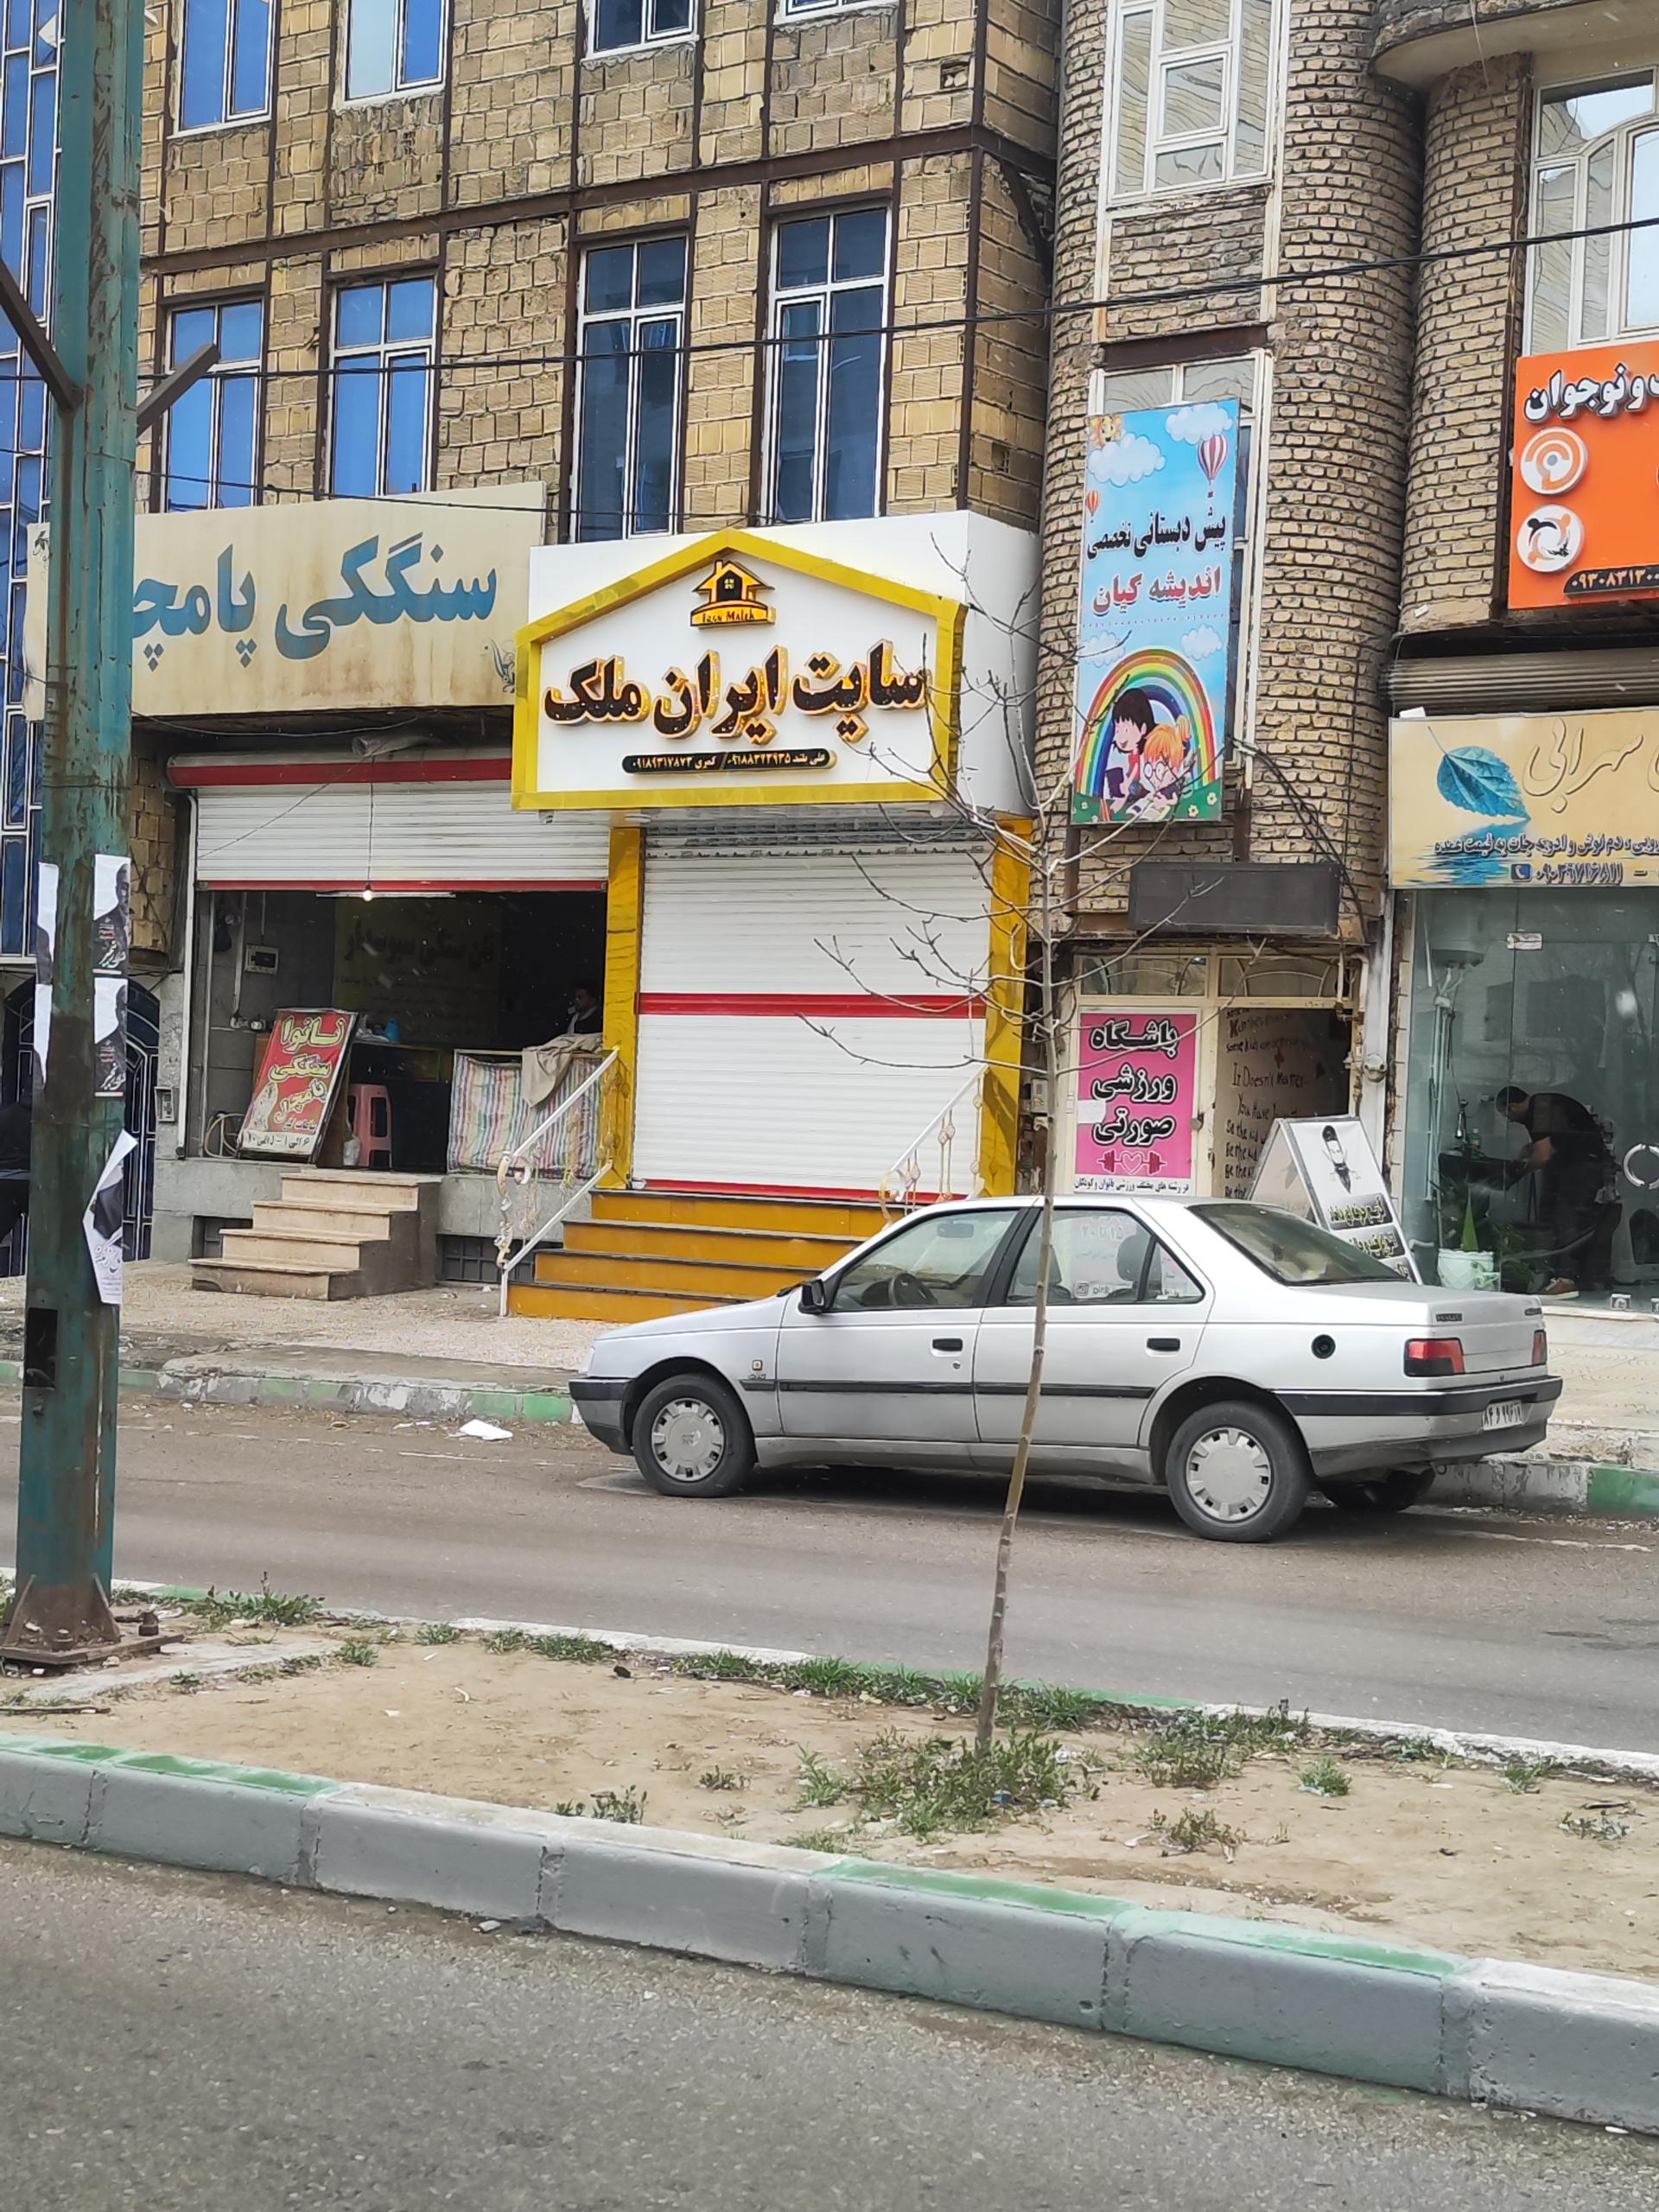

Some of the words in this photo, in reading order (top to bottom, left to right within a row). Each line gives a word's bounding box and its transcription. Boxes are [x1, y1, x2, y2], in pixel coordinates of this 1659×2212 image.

[1523, 363, 1629, 423] نوجوان
[1135, 512, 1191, 557] دبستانی
[1195, 506, 1225, 552] پیش
[131, 543, 257, 671] پامچ
[275, 531, 497, 660] سنگکی
[1093, 573, 1142, 616] کیان
[1149, 566, 1221, 609] اندیشه
[543, 654, 652, 725] ملک
[652, 645, 788, 745] ایران
[792, 639, 931, 743] سایت
[1090, 1019, 1179, 1058] باشگاه
[269, 1053, 332, 1083] سنگکی
[1091, 1063, 1177, 1104] ورزشی
[1092, 1108, 1176, 1147] صورتی
